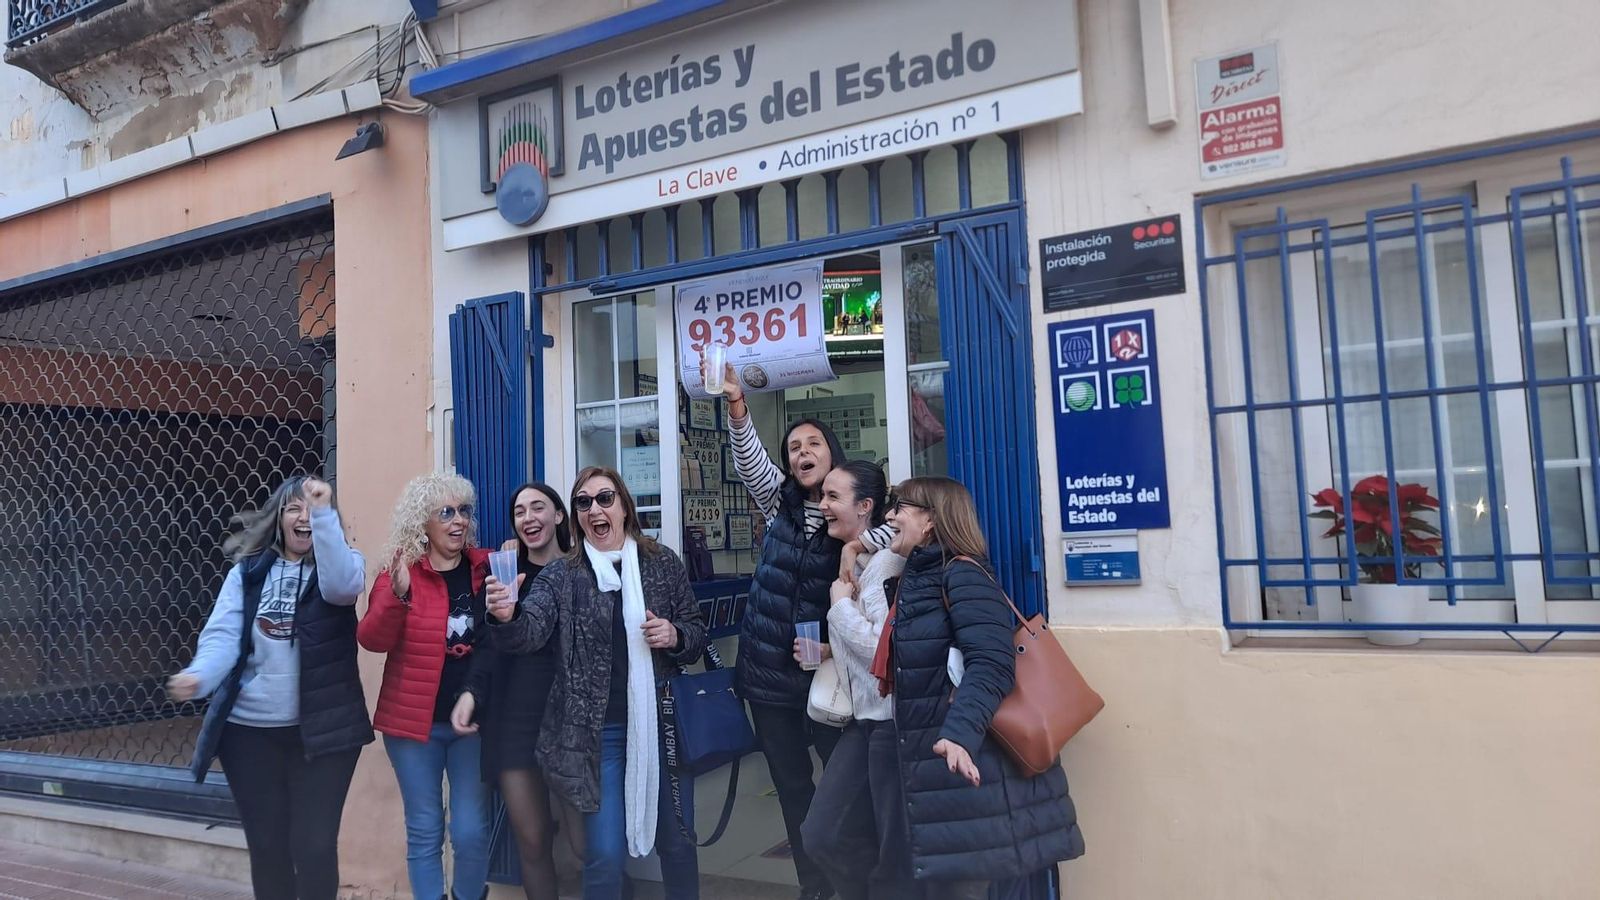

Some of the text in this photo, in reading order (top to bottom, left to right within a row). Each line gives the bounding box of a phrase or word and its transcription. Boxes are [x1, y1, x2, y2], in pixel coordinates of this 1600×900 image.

[575, 44, 755, 120] Loterías y
[578, 32, 996, 174] Apuestas del Estado
[1204, 103, 1278, 129] Alarma
[778, 119, 939, 171] Administración
[991, 101, 1001, 122] 1
[658, 166, 738, 197] La Clave
[1045, 233, 1176, 255] Instalación Securitas
[1046, 250, 1107, 271] protegida
[716, 281, 803, 312] PREMIO
[689, 302, 807, 351] 93361
[1066, 473, 1135, 489] Loterías y
[1068, 487, 1160, 509] Apuestas del
[688, 508, 720, 521] 24339
[1068, 508, 1117, 524] Estado
[664, 722, 677, 767] BIMBAY
[669, 775, 682, 817] BIMBAY
